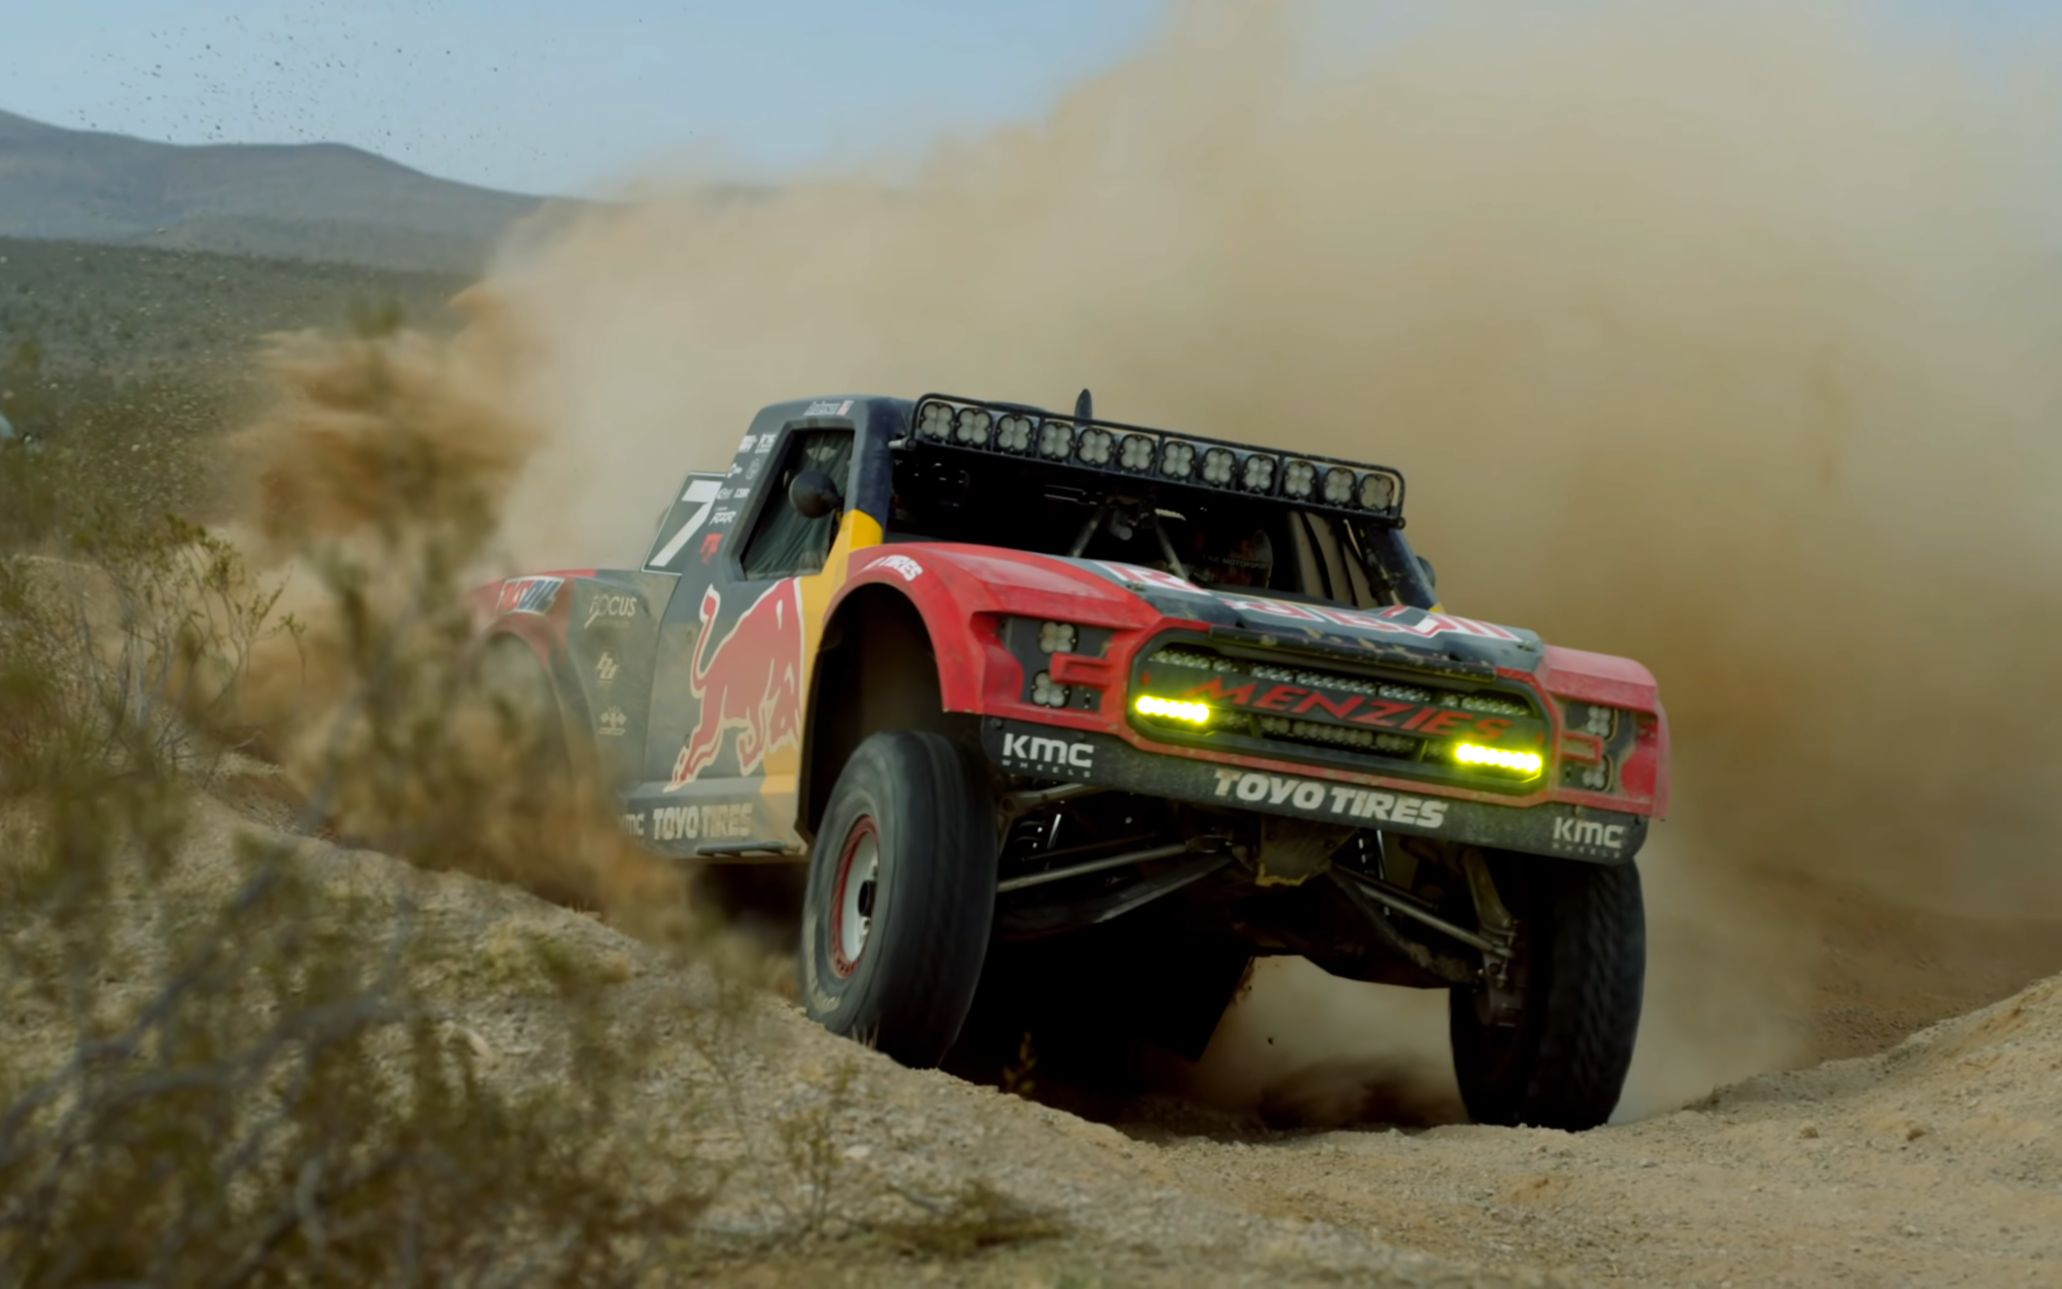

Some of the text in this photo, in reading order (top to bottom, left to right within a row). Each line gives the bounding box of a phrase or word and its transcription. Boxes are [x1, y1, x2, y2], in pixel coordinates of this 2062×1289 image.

[649, 479, 723, 567] 7
[586, 595, 637, 619] FOCUS
[1182, 676, 1513, 742] MENZIES
[653, 805, 699, 841] TOYO
[701, 802, 752, 838] TIRES
[1213, 768, 1449, 829] TOYO TIRES
